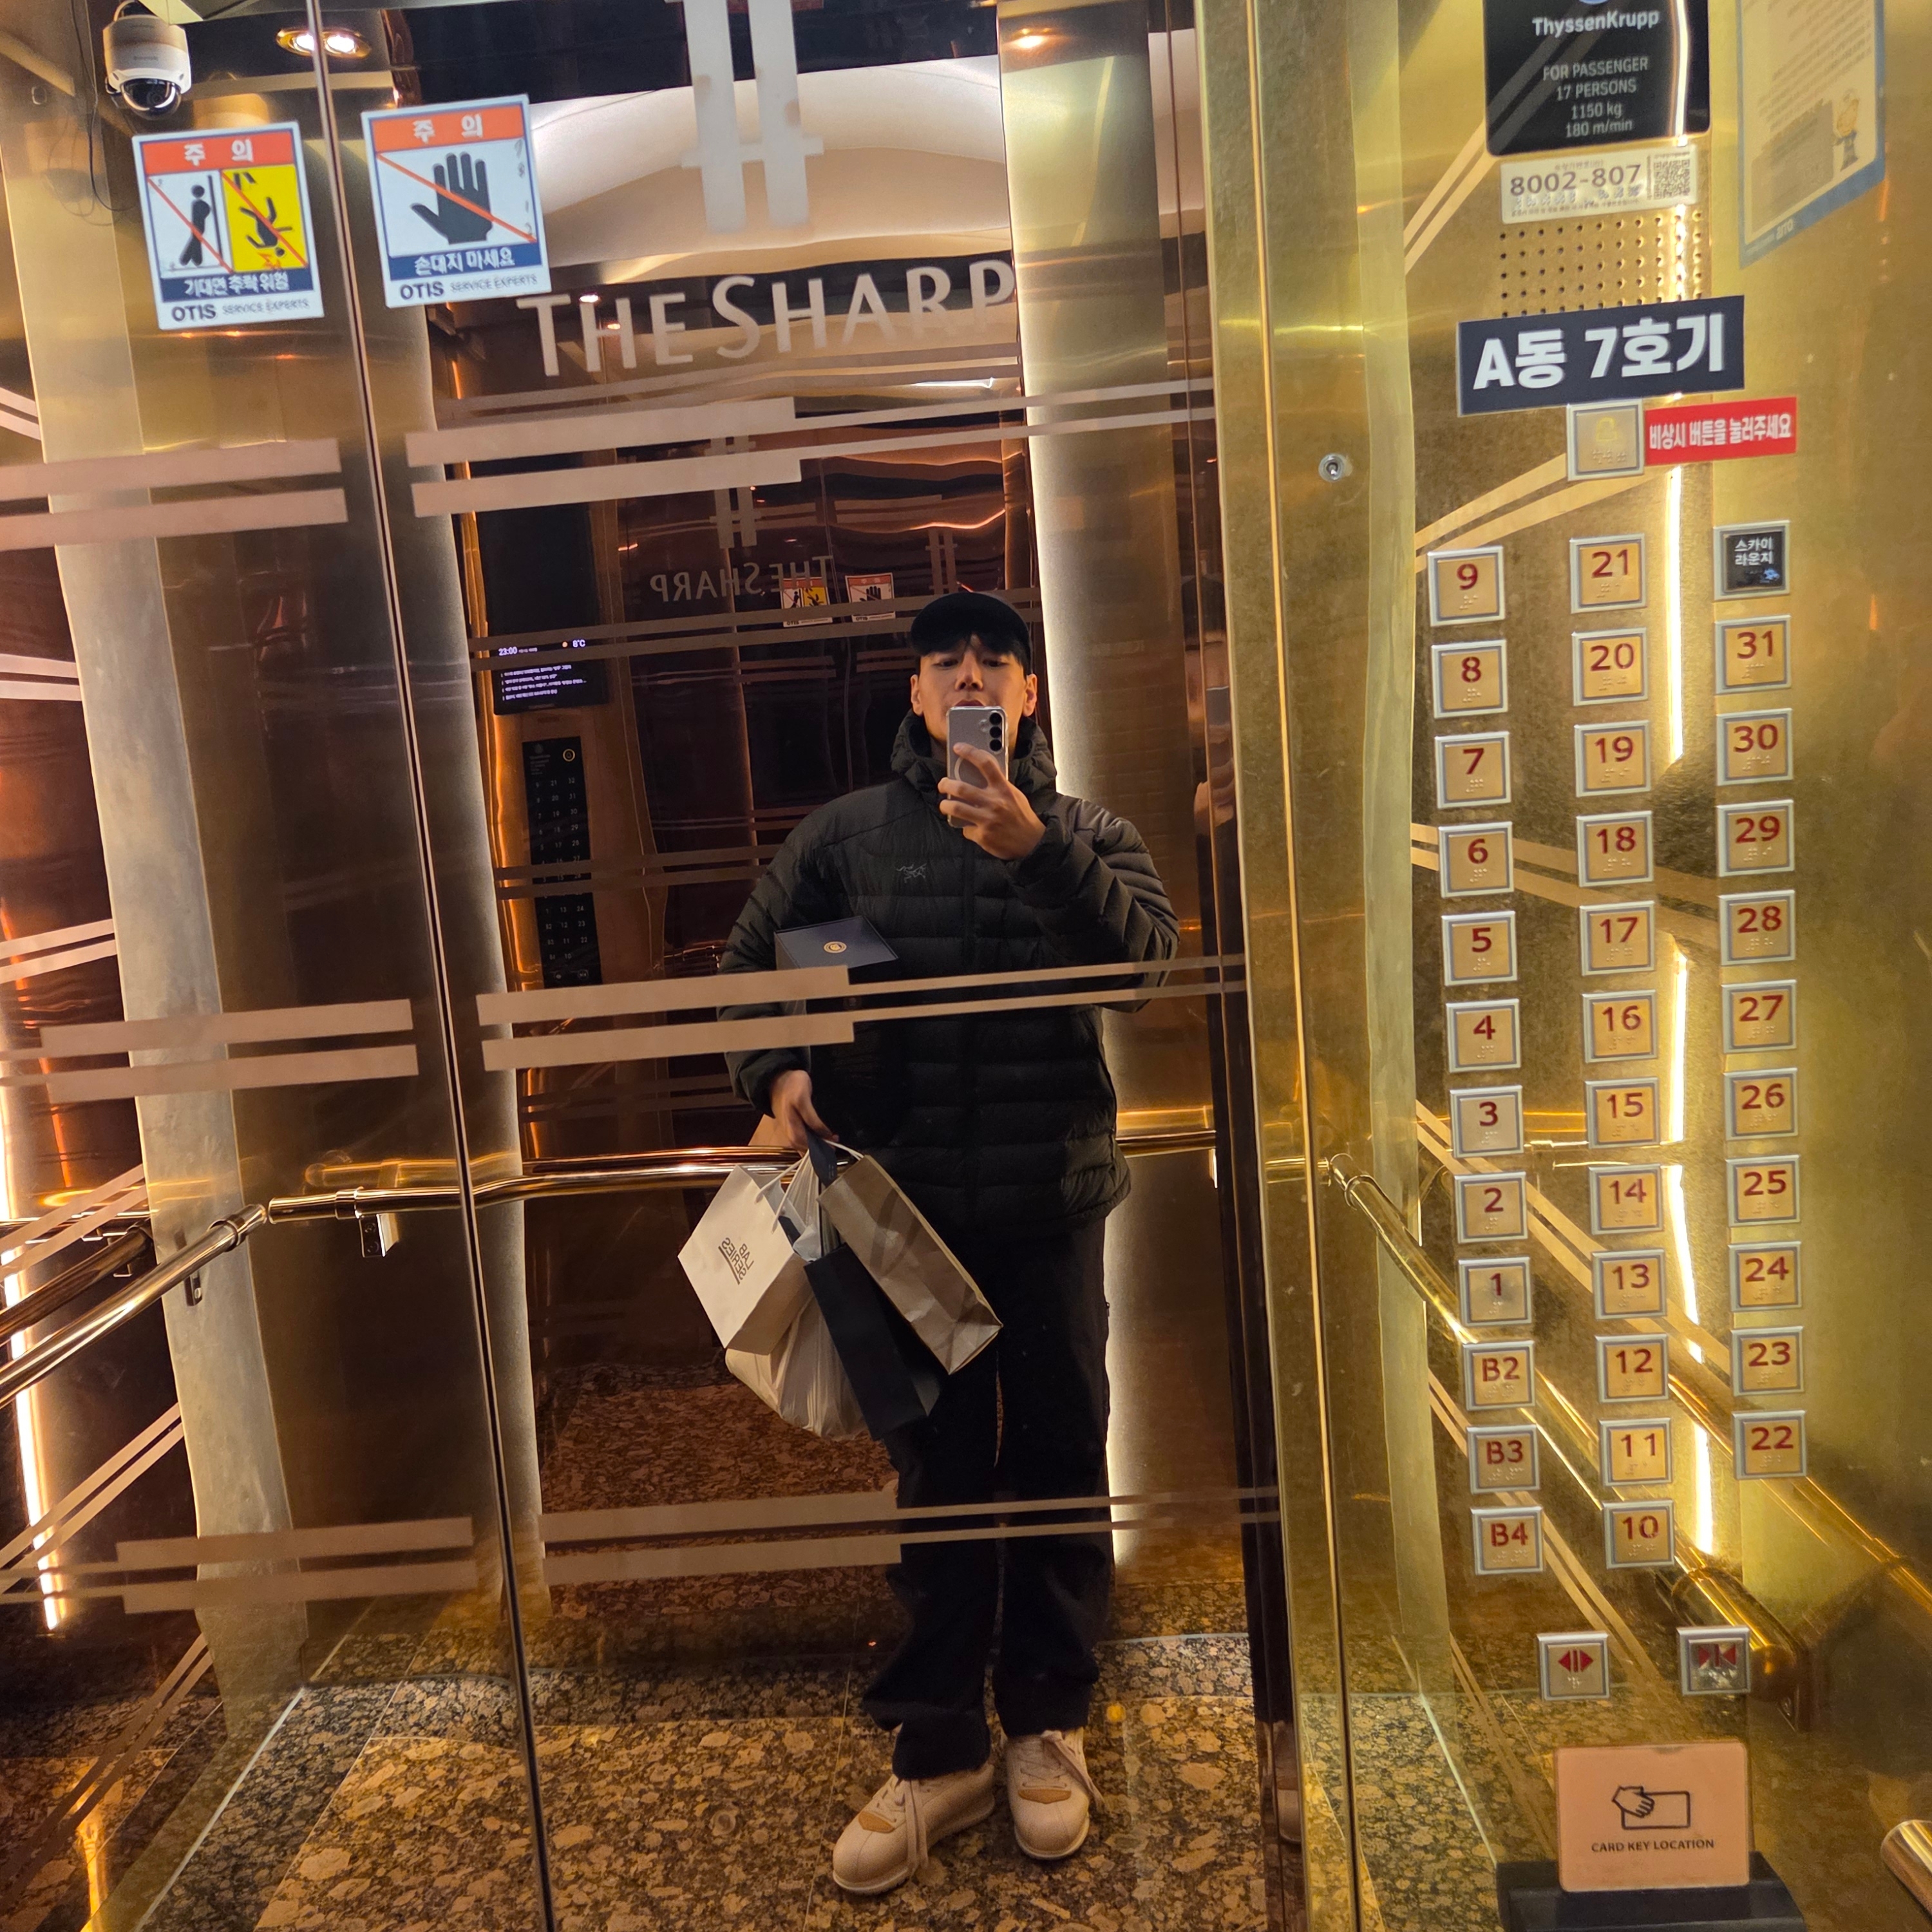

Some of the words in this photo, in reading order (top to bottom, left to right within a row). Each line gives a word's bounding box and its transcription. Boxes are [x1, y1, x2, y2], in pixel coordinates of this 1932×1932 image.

[1532, 10, 1660, 38] ThyssenKrupp
[1543, 64, 1569, 81] FOR
[1573, 56, 1649, 78] PASSENGER
[1556, 85, 1571, 101] 17
[1575, 78, 1637, 98] PERSONS
[1571, 103, 1604, 120] 1150
[1606, 102, 1623, 118] kg
[1565, 122, 1589, 138] 180
[1593, 118, 1633, 135] m/min
[1510, 164, 1641, 196] 8002-807
[414, 251, 464, 276] 손대지
[466, 247, 515, 270] 마세요
[400, 281, 444, 300] OTIS
[171, 303, 216, 321] OTIS
[517, 292, 693, 377] THE
[712, 260, 1016, 359] SHARP
[1473, 328, 1566, 390] A동
[1584, 312, 1725, 379] 7호기
[1649, 420, 1686, 450] 비상시
[1689, 417, 1727, 447] 버튼을
[1728, 412, 1792, 443] 눌러주세요
[1734, 536, 1772, 551] 스카이
[1591, 549, 1631, 578] 21
[1735, 551, 1773, 566] 라운지
[1456, 563, 1479, 589] 9
[1589, 643, 1635, 671] 20
[1736, 630, 1774, 659] 31
[1461, 656, 1482, 682] 8
[1594, 736, 1633, 763] 19
[1733, 724, 1779, 752] 30
[1462, 748, 1484, 774] 7
[1596, 826, 1636, 854] 18
[1734, 816, 1781, 842] 29
[1467, 838, 1488, 863] 6
[1599, 917, 1638, 943] 17
[1736, 906, 1782, 933] 28
[1471, 928, 1492, 952] 5
[1602, 1006, 1642, 1031] 16
[1739, 995, 1783, 1021] 27
[1473, 1016, 1495, 1039] 4
[1606, 1093, 1643, 1118] 15
[1741, 1084, 1786, 1109] 26
[1479, 1103, 1499, 1126] 3
[1609, 1179, 1646, 1204] 14
[1743, 1170, 1787, 1195] 25
[1483, 1188, 1504, 1212] 2
[1612, 1264, 1649, 1289] 13
[1745, 1257, 1789, 1281] 24
[1490, 1274, 1503, 1295] 1
[1615, 1350, 1653, 1373] 12
[1748, 1343, 1790, 1366] 23
[1481, 1358, 1520, 1381] B2
[1620, 1434, 1657, 1457] 11
[1751, 1427, 1794, 1450] 22
[1486, 1441, 1524, 1464] B3
[1490, 1524, 1528, 1546] B4
[1622, 1517, 1659, 1539] 10
[1591, 1841, 1624, 1853] CARD
[1627, 1840, 1651, 1852] KEY
[1653, 1838, 1715, 1851] LOCATION
